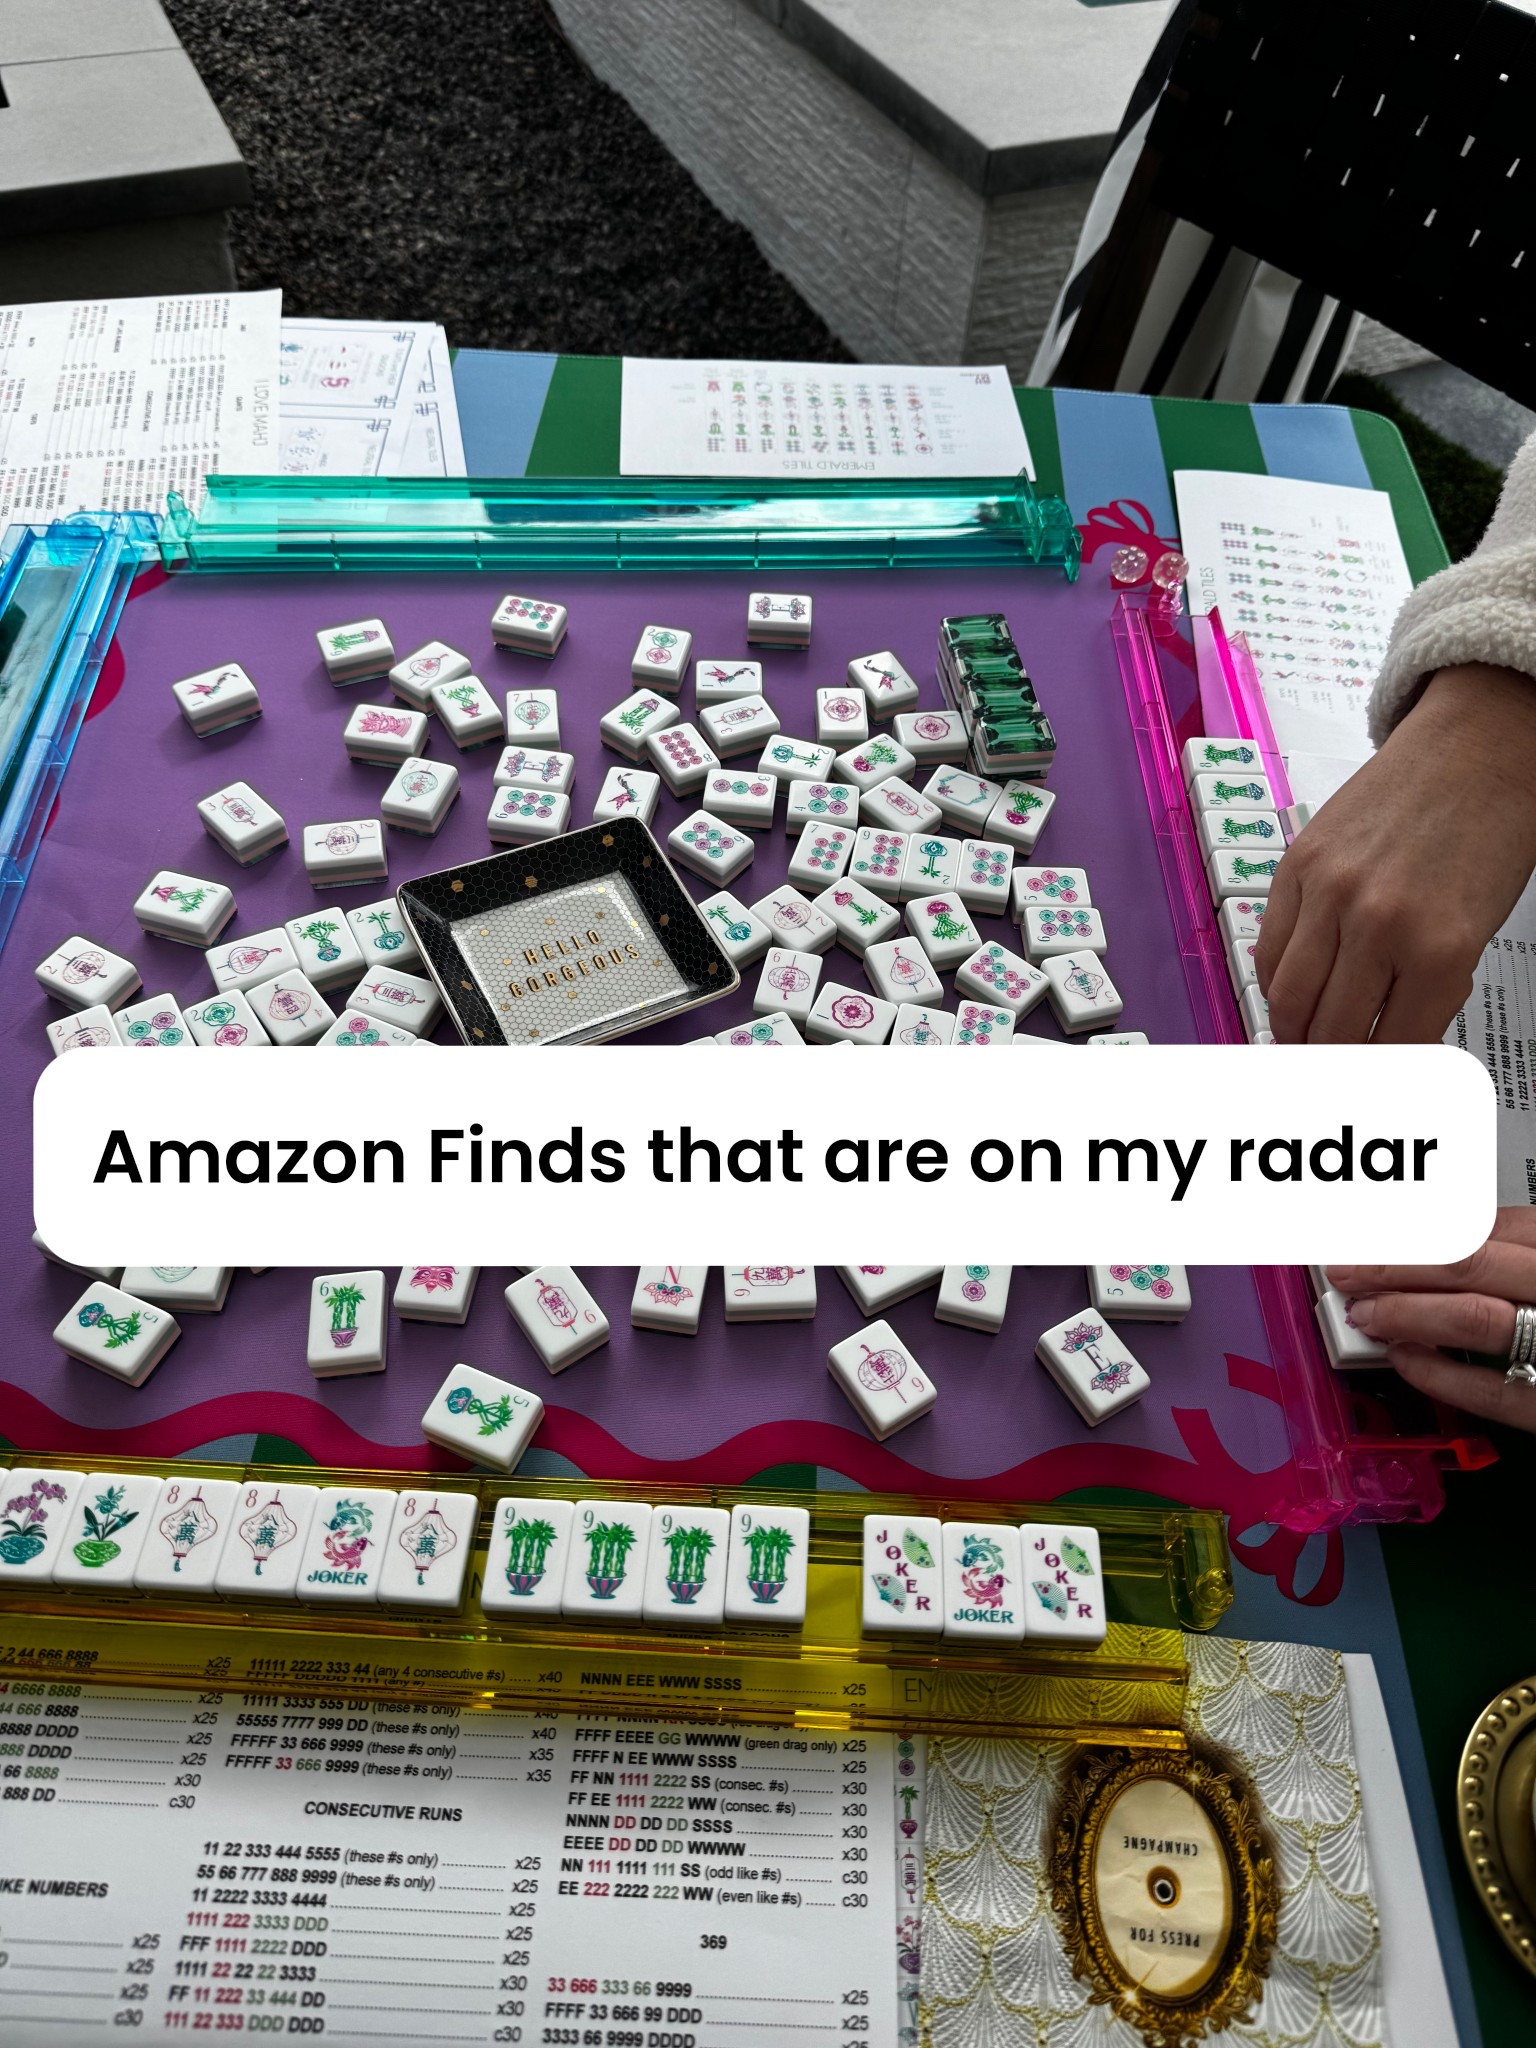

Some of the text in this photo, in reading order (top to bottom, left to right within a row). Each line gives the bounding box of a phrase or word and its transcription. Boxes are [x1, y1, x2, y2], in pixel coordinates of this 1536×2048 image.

[782, 460, 875, 470] EMERALD TILES
[1200, 567, 1214, 587] TILES
[524, 929, 603, 968] HELLO
[509, 943, 642, 1000] GORGEOUS
[167, 1485, 180, 1504] 8
[245, 1489, 258, 1508] 8
[404, 1497, 416, 1517] 8
[502, 1505, 518, 1526] 9
[582, 1509, 596, 1530] 9
[659, 1513, 674, 1534] 9
[739, 1512, 753, 1533] 9
[307, 1570, 368, 1586] JOKER
[952, 1607, 1014, 1625] JOKER
[581, 1672, 866, 1696] NNNN EEE WWW SSSS x25
[236, 1714, 278, 1727] 55555
[282, 1715, 314, 1729] 7777
[318, 1717, 343, 1730] 999
[347, 1719, 368, 1732] DD
[371, 1720, 409, 1735] (these
[430, 1722, 460, 1738] only)
[531, 1727, 557, 1740] x40
[575, 1728, 867, 1753] FFFF EEEE GG WWWW (green drag only) x25
[573, 1750, 867, 1773] FFFF N EE WWW SSSS x25
[570, 1771, 867, 1795] FF NN 1111 2222 SS (consec. #s) x30
[304, 1801, 463, 1822] CONSECUTIVE RUNS
[568, 1792, 867, 1817] FF EE 1111 2222 WW (consec. #s) x30
[566, 1814, 868, 1838] NNNN DD DD DD SSSS x30
[204, 1842, 219, 1856] 11
[223, 1843, 242, 1857] 22
[245, 1844, 272, 1858] 333
[275, 1845, 302, 1859] 444
[306, 1846, 341, 1861] 5555
[344, 1848, 384, 1865] (these
[407, 1852, 438, 1869] only)
[515, 1856, 542, 1870] x25
[563, 1836, 868, 1861] EEEE DD DD DD WWWW x30
[1123, 1835, 1199, 1856] CHAMPAGNE
[561, 1858, 868, 1884] NN 111 1111 111 SS (odd like #s) c30
[27, 1878, 109, 1898] NUMBERS
[558, 1881, 868, 1908] EE 222 2222 222 WW (even like #s) c30
[699, 1934, 728, 1950] 369
[1129, 1926, 1200, 1948] PRESS FOR
